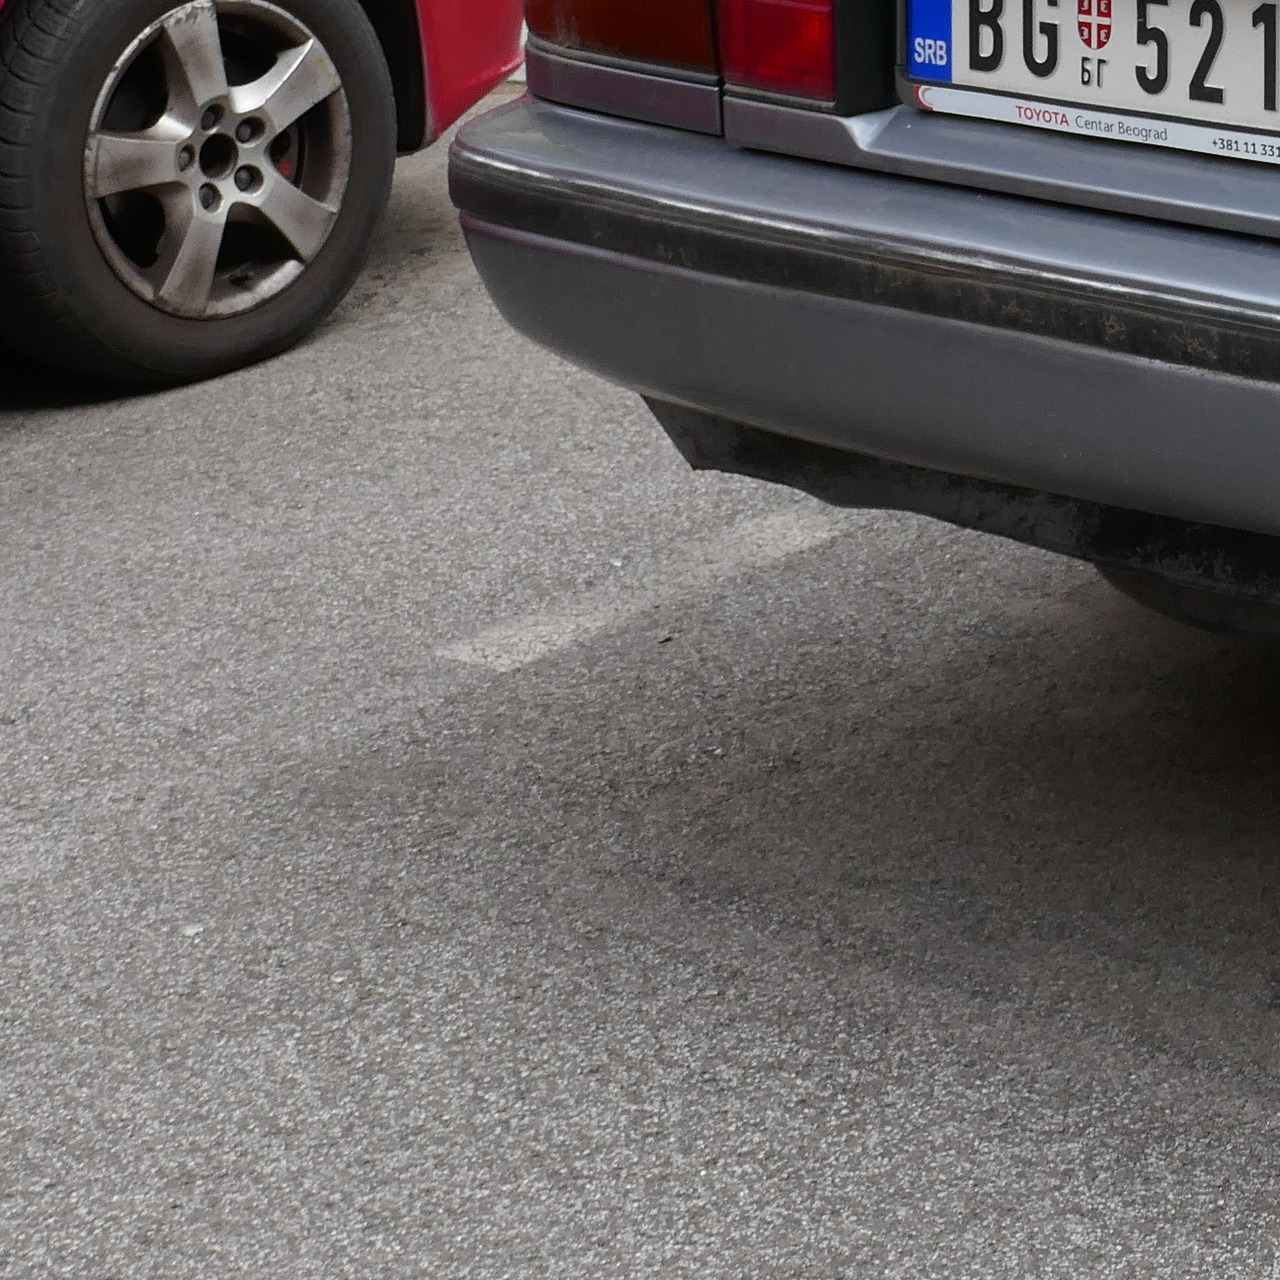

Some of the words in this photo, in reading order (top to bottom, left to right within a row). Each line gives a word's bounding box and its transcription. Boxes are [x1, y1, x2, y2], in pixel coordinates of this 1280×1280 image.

[914, 37, 947, 66] SRB
[1081, 56, 1109, 87] БГ
[1015, 105, 1070, 127] TOYOTA
[1075, 115, 1115, 133] Centar
[1117, 121, 1168, 142] Beograd
[1212, 138, 1241, 152] +381
[1244, 142, 1258, 155] 11
